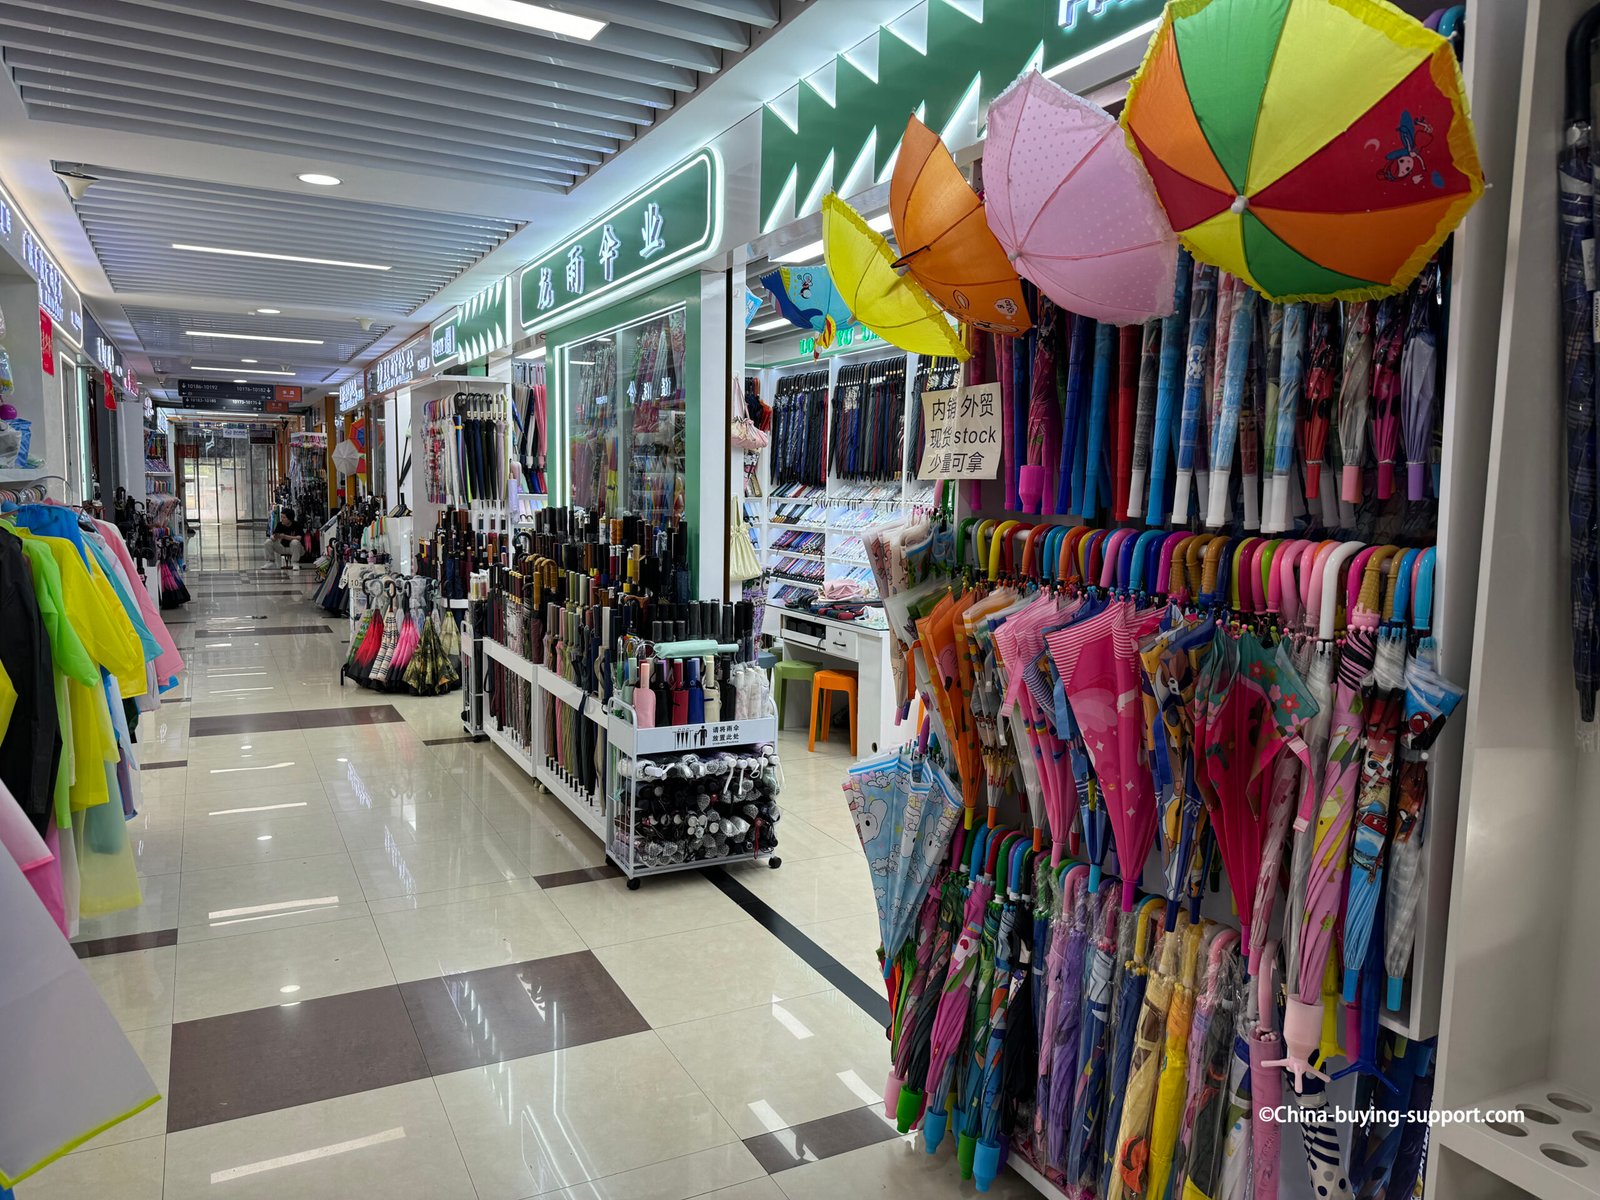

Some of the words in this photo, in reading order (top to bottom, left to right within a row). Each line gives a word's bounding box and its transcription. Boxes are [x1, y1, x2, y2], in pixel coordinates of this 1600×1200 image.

[837, 327, 854, 347] YU
[928, 451, 985, 474] 少量可拿
